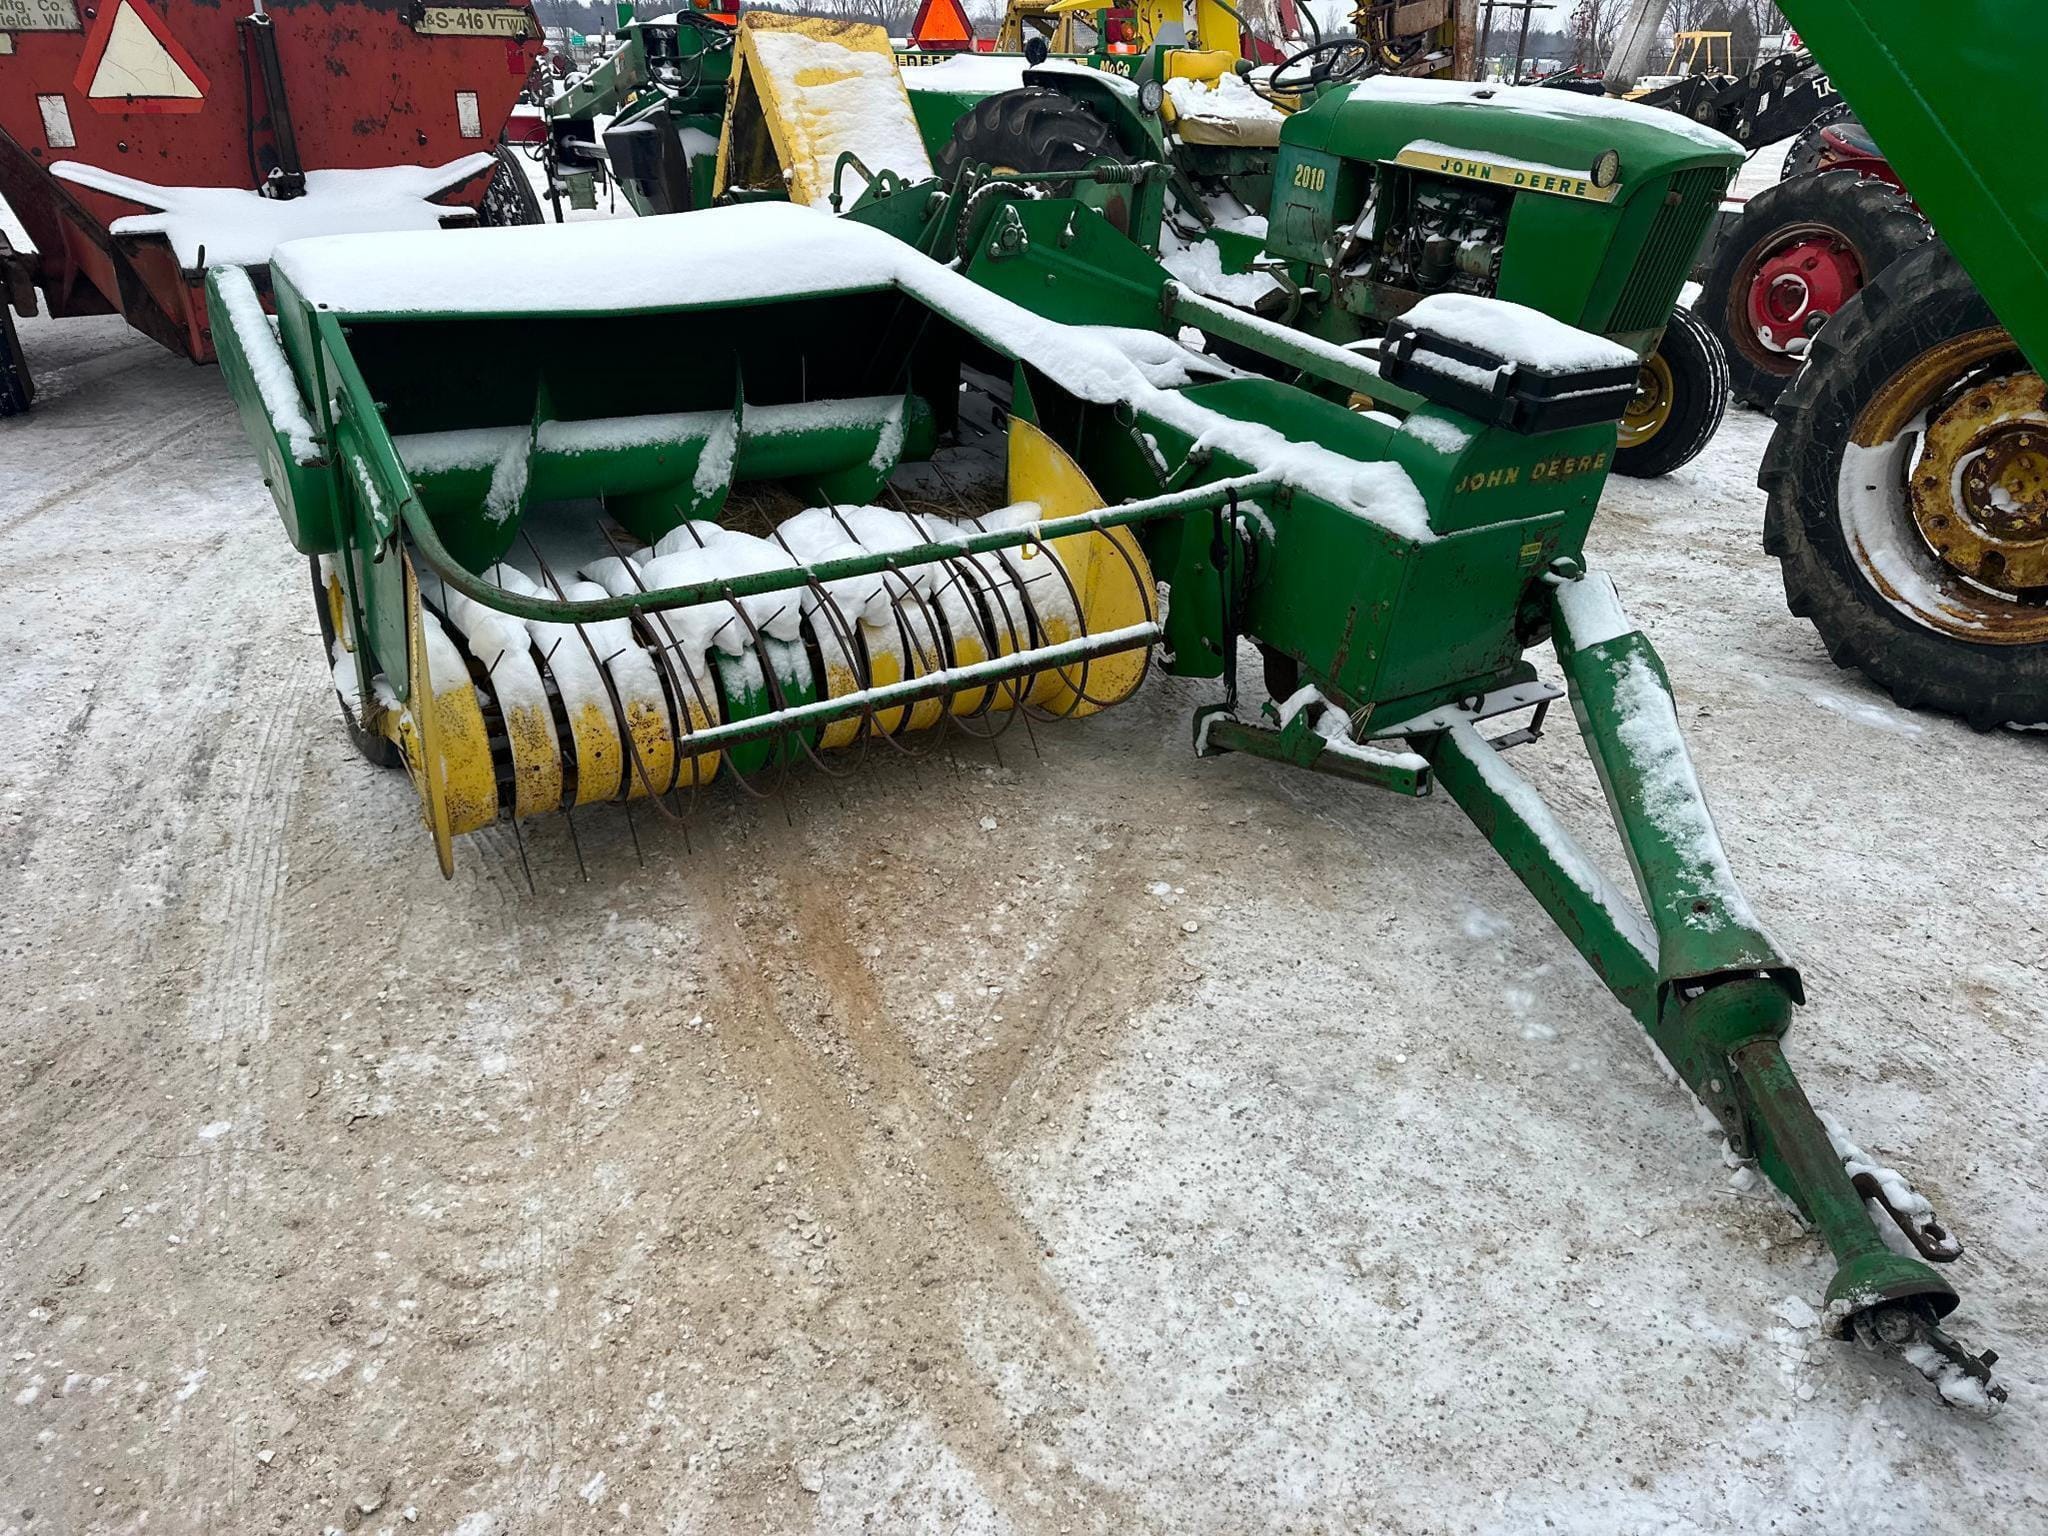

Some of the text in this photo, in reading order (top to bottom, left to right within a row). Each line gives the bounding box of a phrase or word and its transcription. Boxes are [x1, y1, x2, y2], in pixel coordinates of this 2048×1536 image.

[1294, 163, 1326, 192] 2010
[1441, 159, 1587, 196] JOHN DEERE
[1455, 452, 1607, 494] JOHN DEERE
